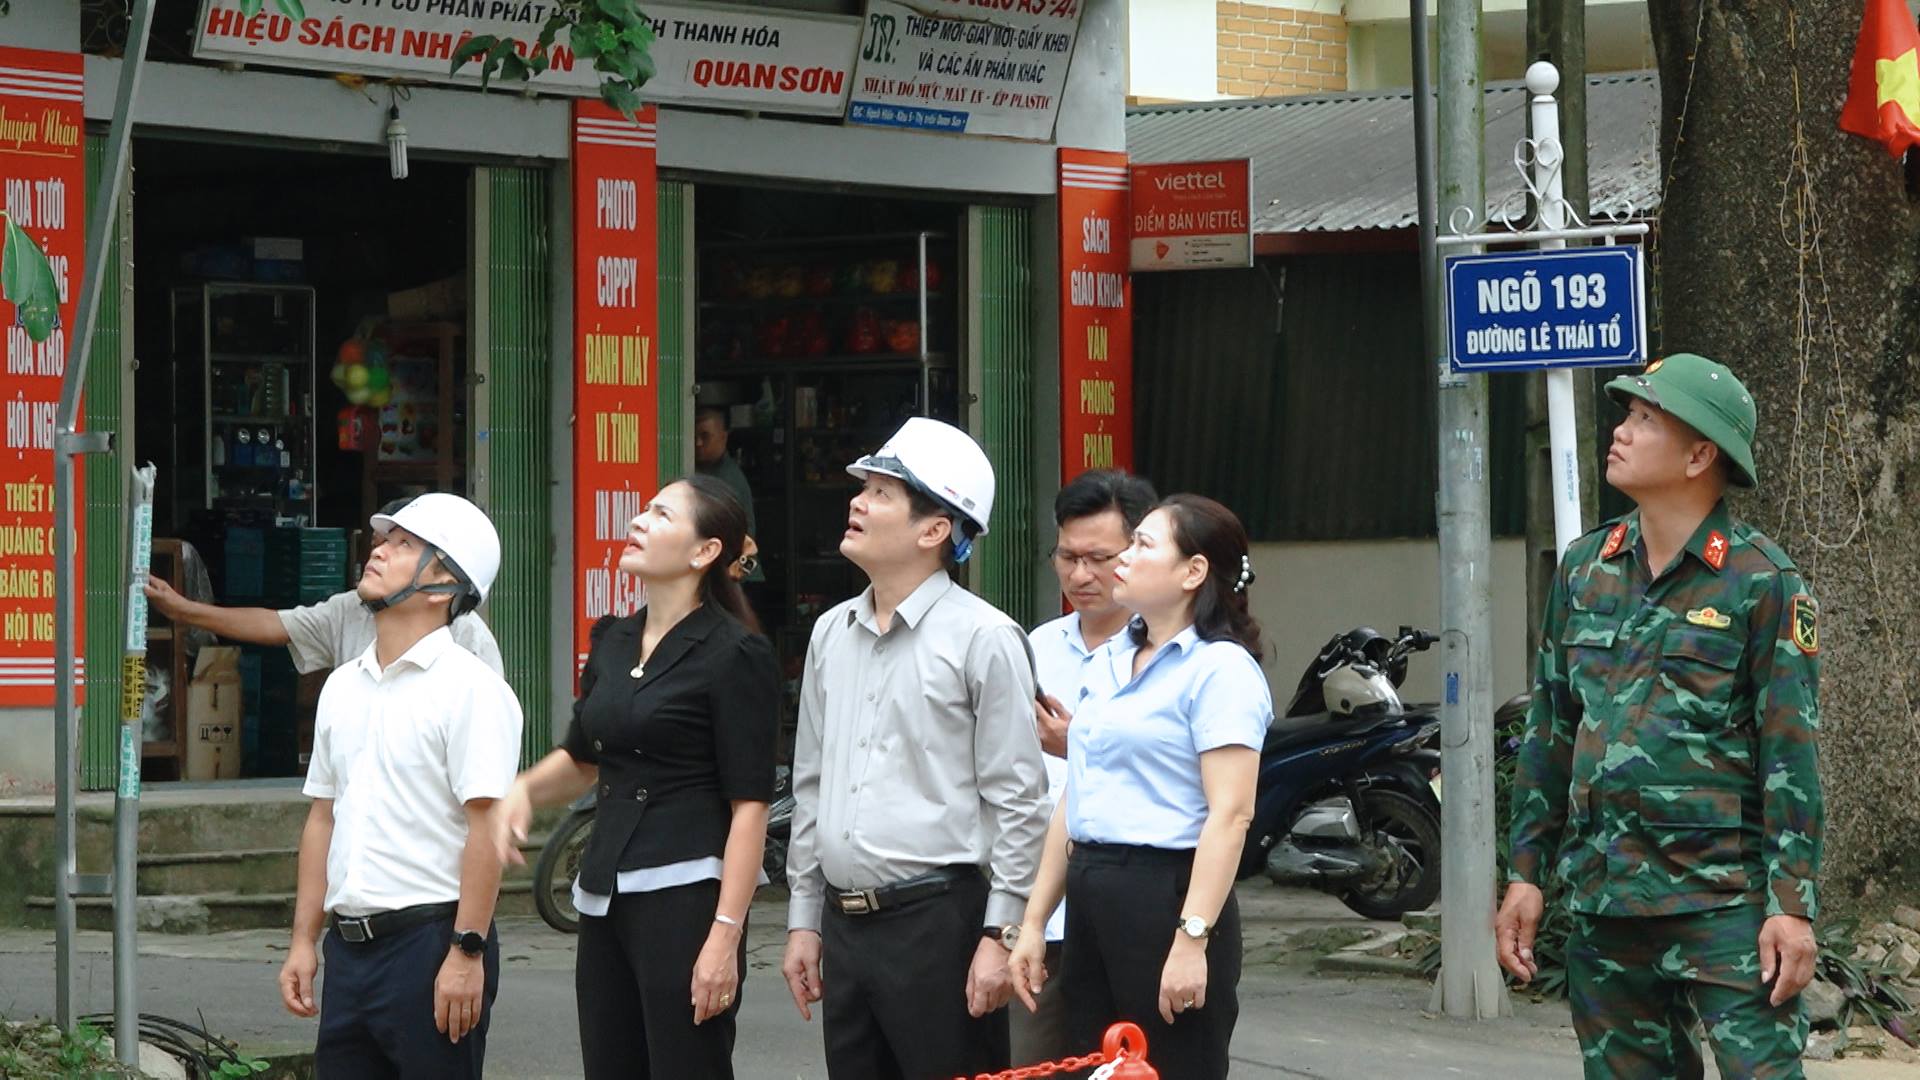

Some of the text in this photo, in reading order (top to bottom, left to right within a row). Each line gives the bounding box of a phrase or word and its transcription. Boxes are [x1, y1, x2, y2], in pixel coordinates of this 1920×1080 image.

[490, 1, 545, 23] PHÁT
[298, 15, 395, 54] SÁCH
[673, 21, 737, 44] THANH
[741, 26, 780, 48] HÓA
[694, 59, 844, 95] QUAN SƠN
[918, 47, 1046, 84] VÀ CÁC ẤN PHẨM KHÁC
[1010, 93, 1053, 110] PLASTIC
[1154, 171, 1226, 191] viettel
[6, 177, 65, 230] HOA TƯƠI
[597, 177, 637, 231] PHOTO
[1135, 204, 1246, 232] ĐIỂM BÁN VIETTEL
[1082, 210, 1110, 254] SÁCH
[597, 256, 637, 308] COPPY
[1070, 265, 1124, 308] GIÁO KHOA
[1478, 270, 1606, 314] NGÕ 193
[7, 325, 34, 376] HOA
[585, 324, 650, 386] ĐÁNH MÁY
[1087, 319, 1107, 361] VĂN
[1467, 313, 1621, 355] ĐƯỜNG LÊ THÁI TỔ
[1081, 372, 1115, 416] PHÒNG
[7, 390, 30, 460] HỘI
[596, 401, 639, 463] VI TÍNH
[1083, 419, 1113, 468] PHẨM
[5, 475, 45, 512] THIẾT
[596, 490, 609, 540] IN
[585, 547, 610, 618] KHỔ
[4, 607, 29, 648] HỘI
